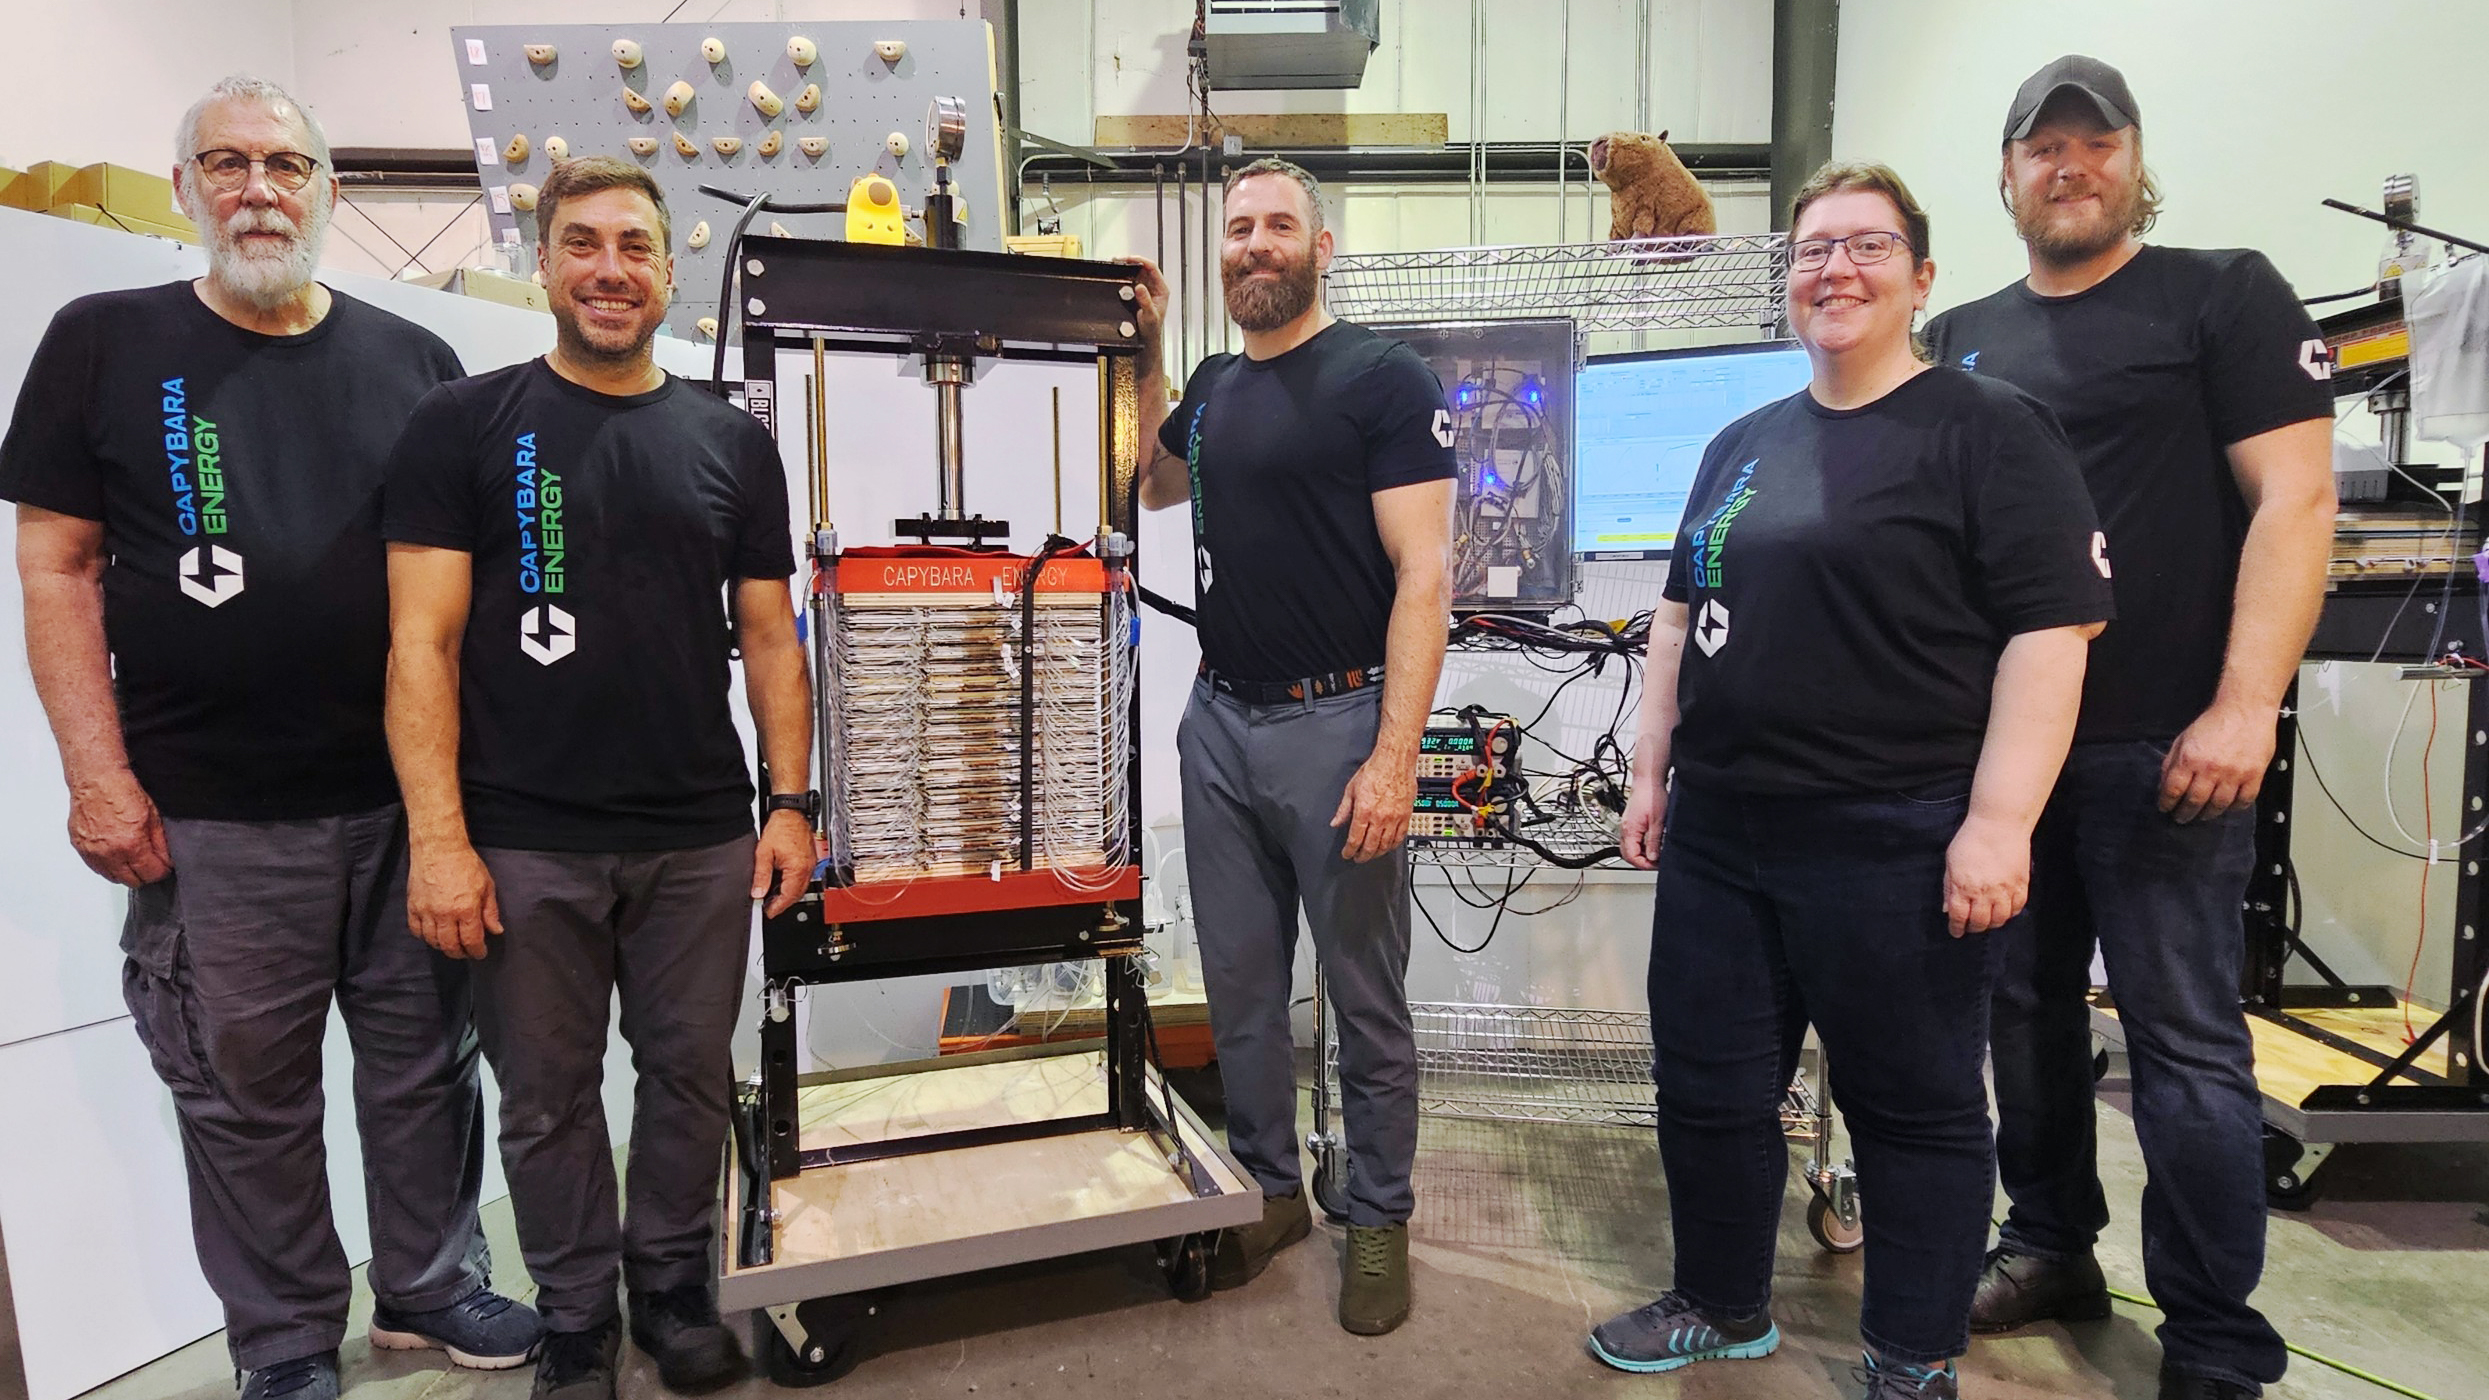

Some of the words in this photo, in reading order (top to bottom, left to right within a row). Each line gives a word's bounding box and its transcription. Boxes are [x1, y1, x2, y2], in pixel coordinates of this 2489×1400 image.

[162, 377, 197, 536] CAPYBARA
[193, 415, 228, 534] ENERGY
[516, 432, 541, 594] CAPYBARA
[541, 467, 565, 594] ENERGY
[883, 566, 975, 586] CAPYBARA
[1002, 566, 1068, 586] ENRGY
[1706, 487, 1758, 588] ENERGY
